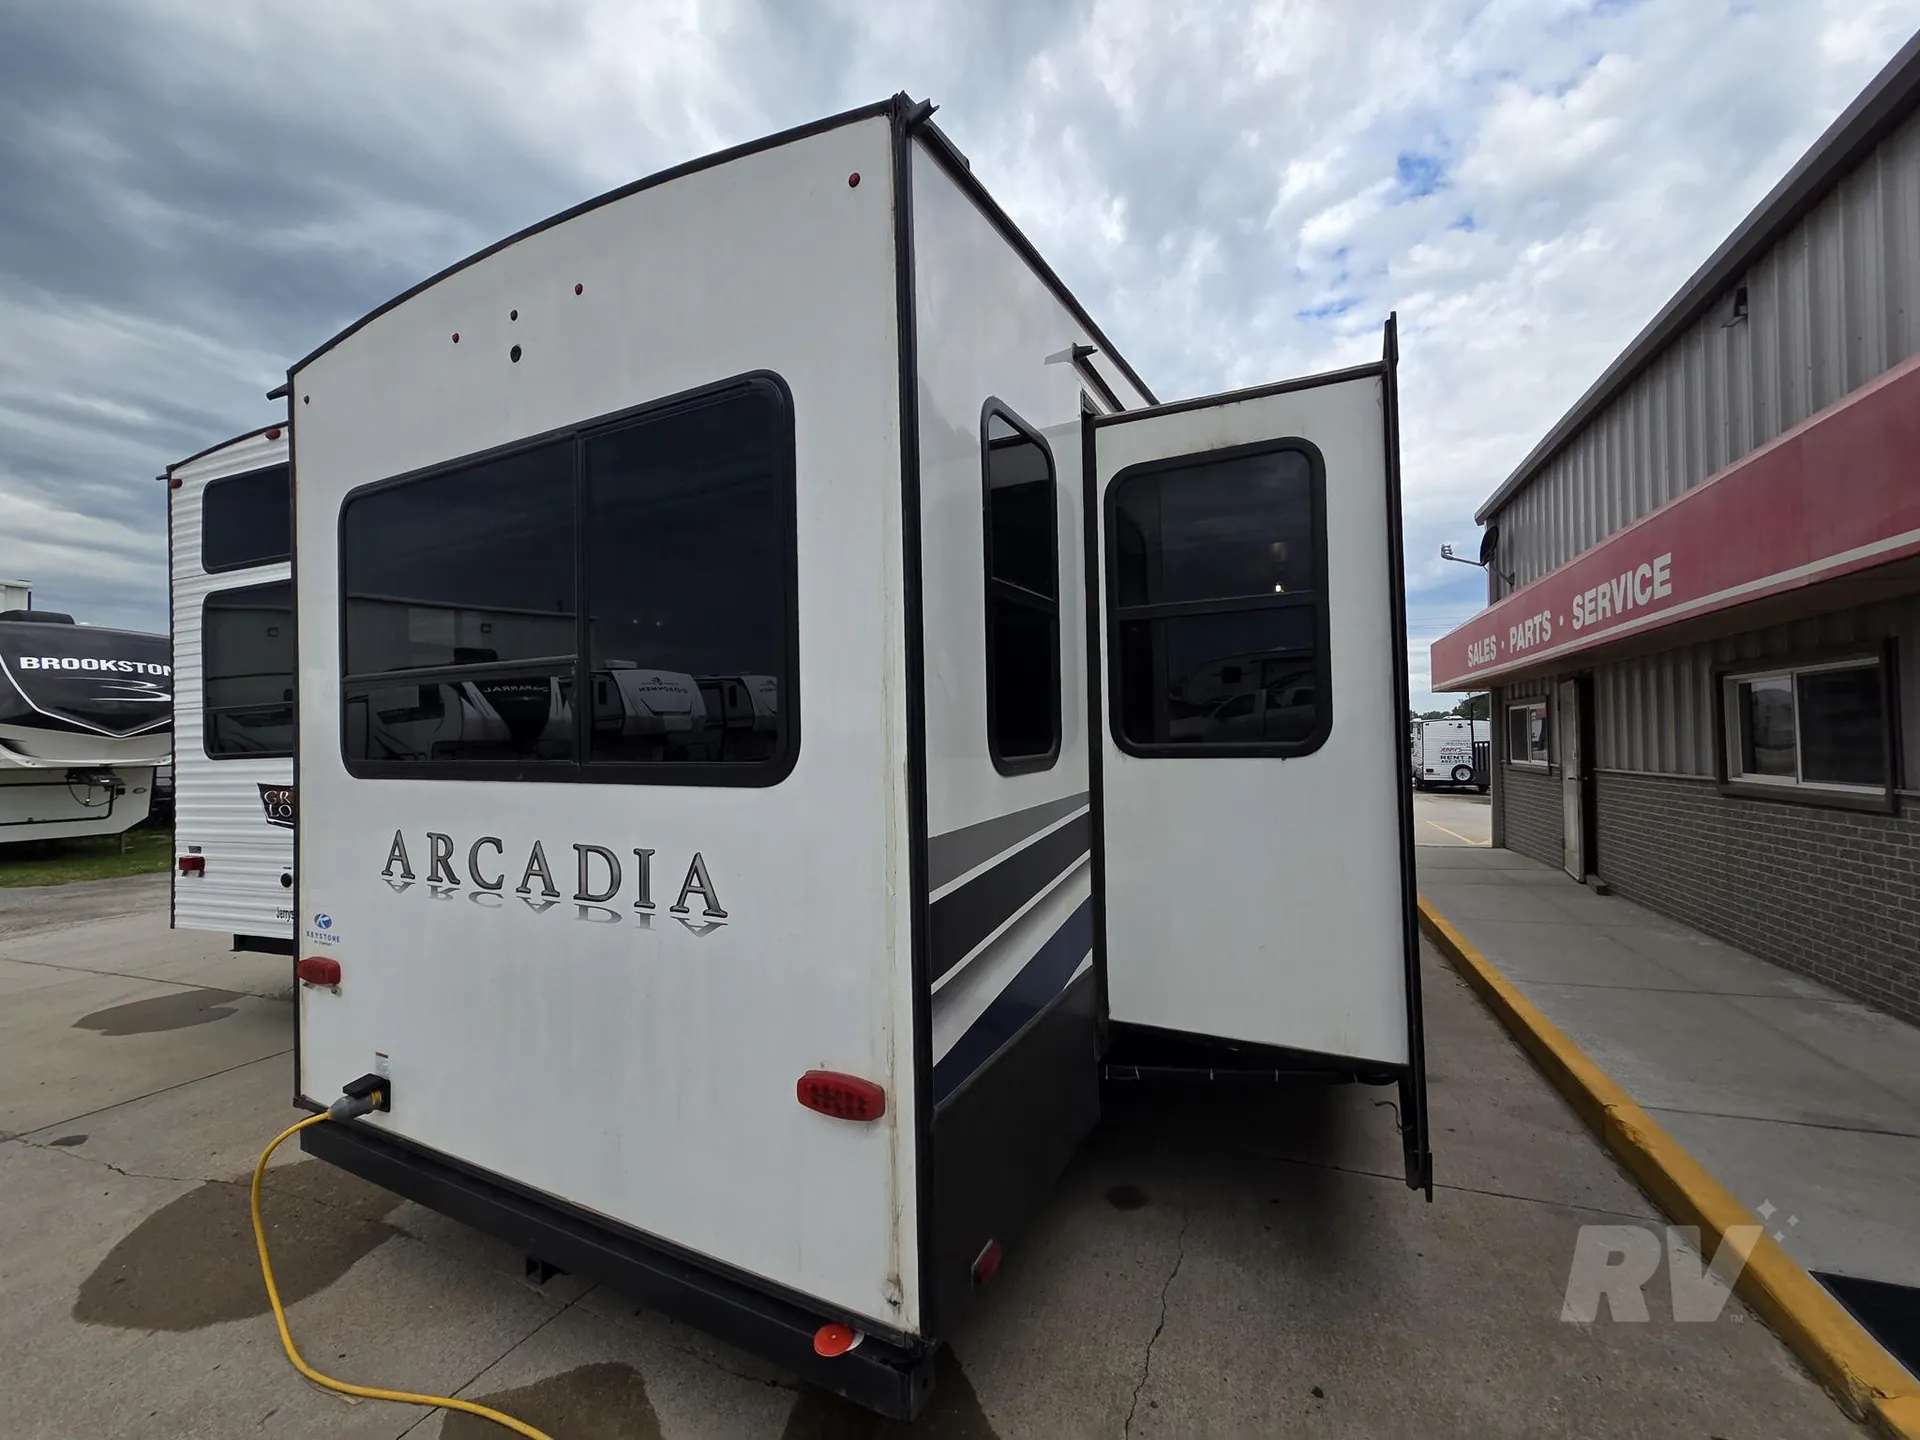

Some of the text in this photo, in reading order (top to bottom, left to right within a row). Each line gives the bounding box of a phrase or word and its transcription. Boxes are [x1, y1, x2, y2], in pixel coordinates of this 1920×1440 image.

[1467, 552, 1672, 668] SALES PARTS SERVICE
[381, 828, 729, 919] ARCADIA
[306, 930, 341, 944] KEYSTONE
